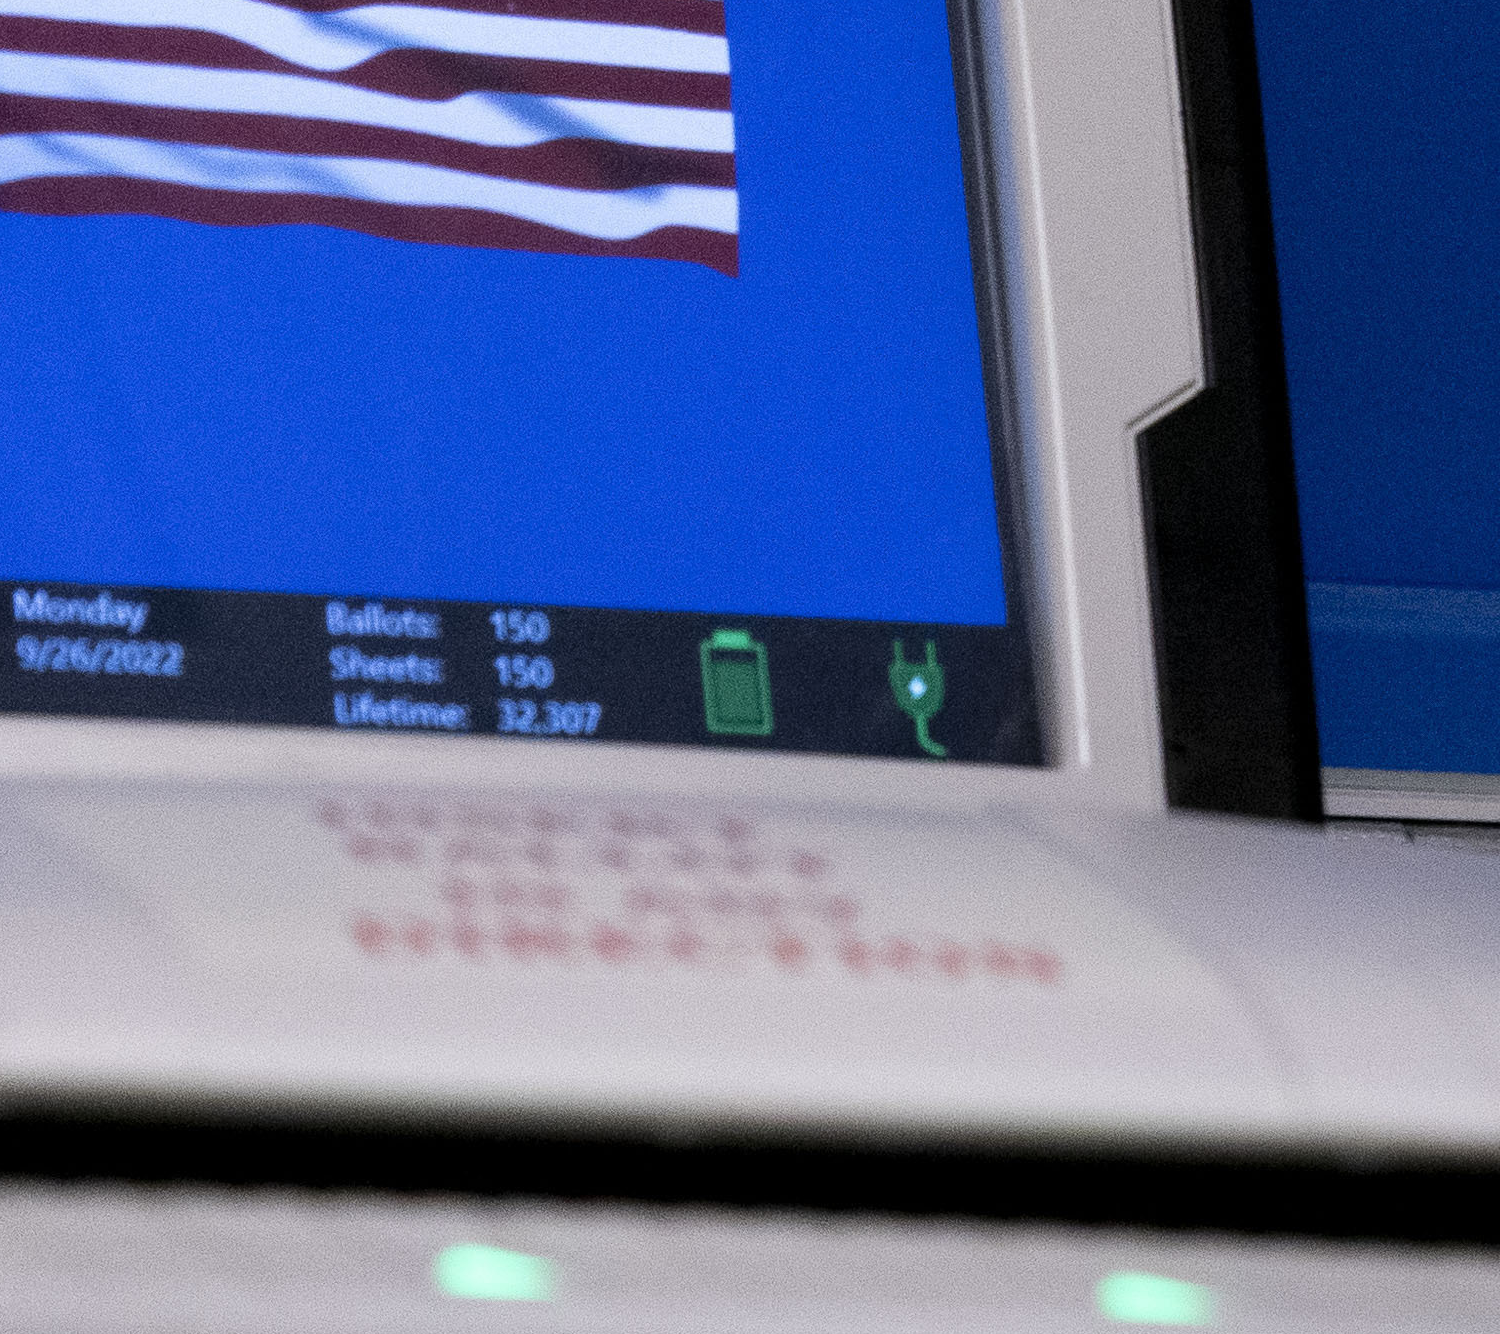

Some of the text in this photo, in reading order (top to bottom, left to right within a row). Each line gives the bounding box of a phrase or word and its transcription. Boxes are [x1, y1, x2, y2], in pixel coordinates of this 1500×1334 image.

[12, 588, 148, 633] Monday
[325, 600, 550, 643] Ballots: 150
[15, 635, 185, 677] 9/26/2022
[328, 645, 554, 689] Sheets: 150
[333, 691, 468, 730] Lifetime:
[348, 913, 1067, 984] DIRECTION
